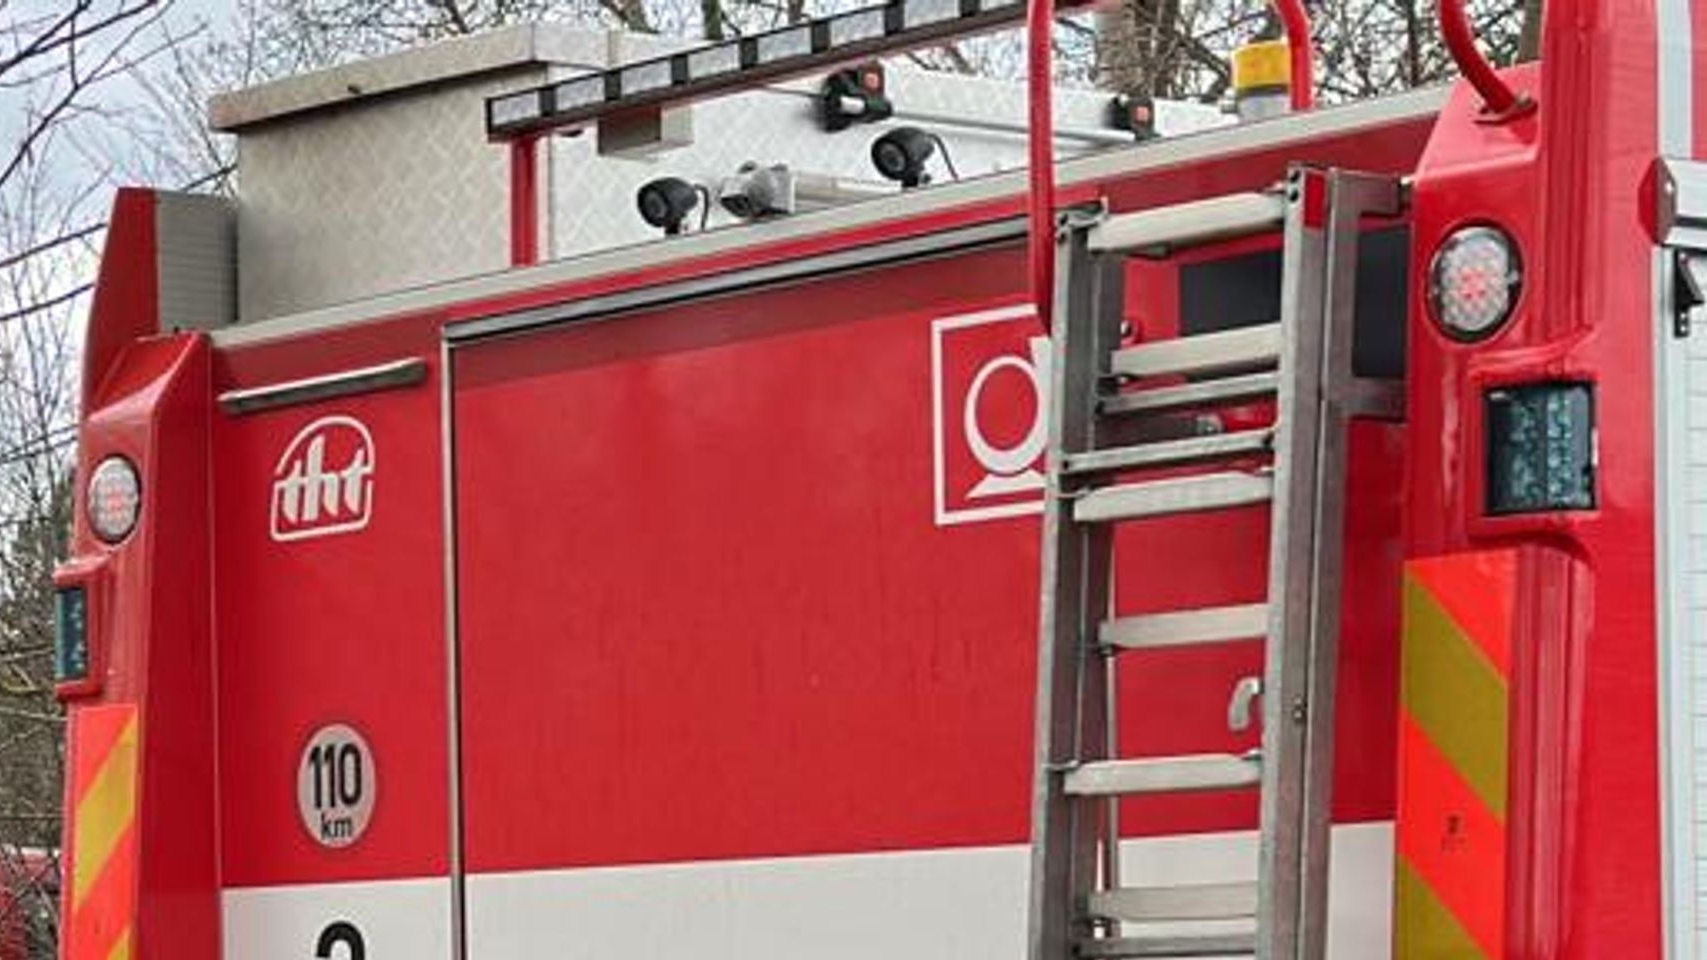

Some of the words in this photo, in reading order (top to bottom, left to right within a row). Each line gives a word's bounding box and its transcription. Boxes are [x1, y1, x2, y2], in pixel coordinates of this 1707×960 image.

[275, 433, 371, 525] tht
[309, 742, 362, 810] 110
[320, 811, 352, 840] km
